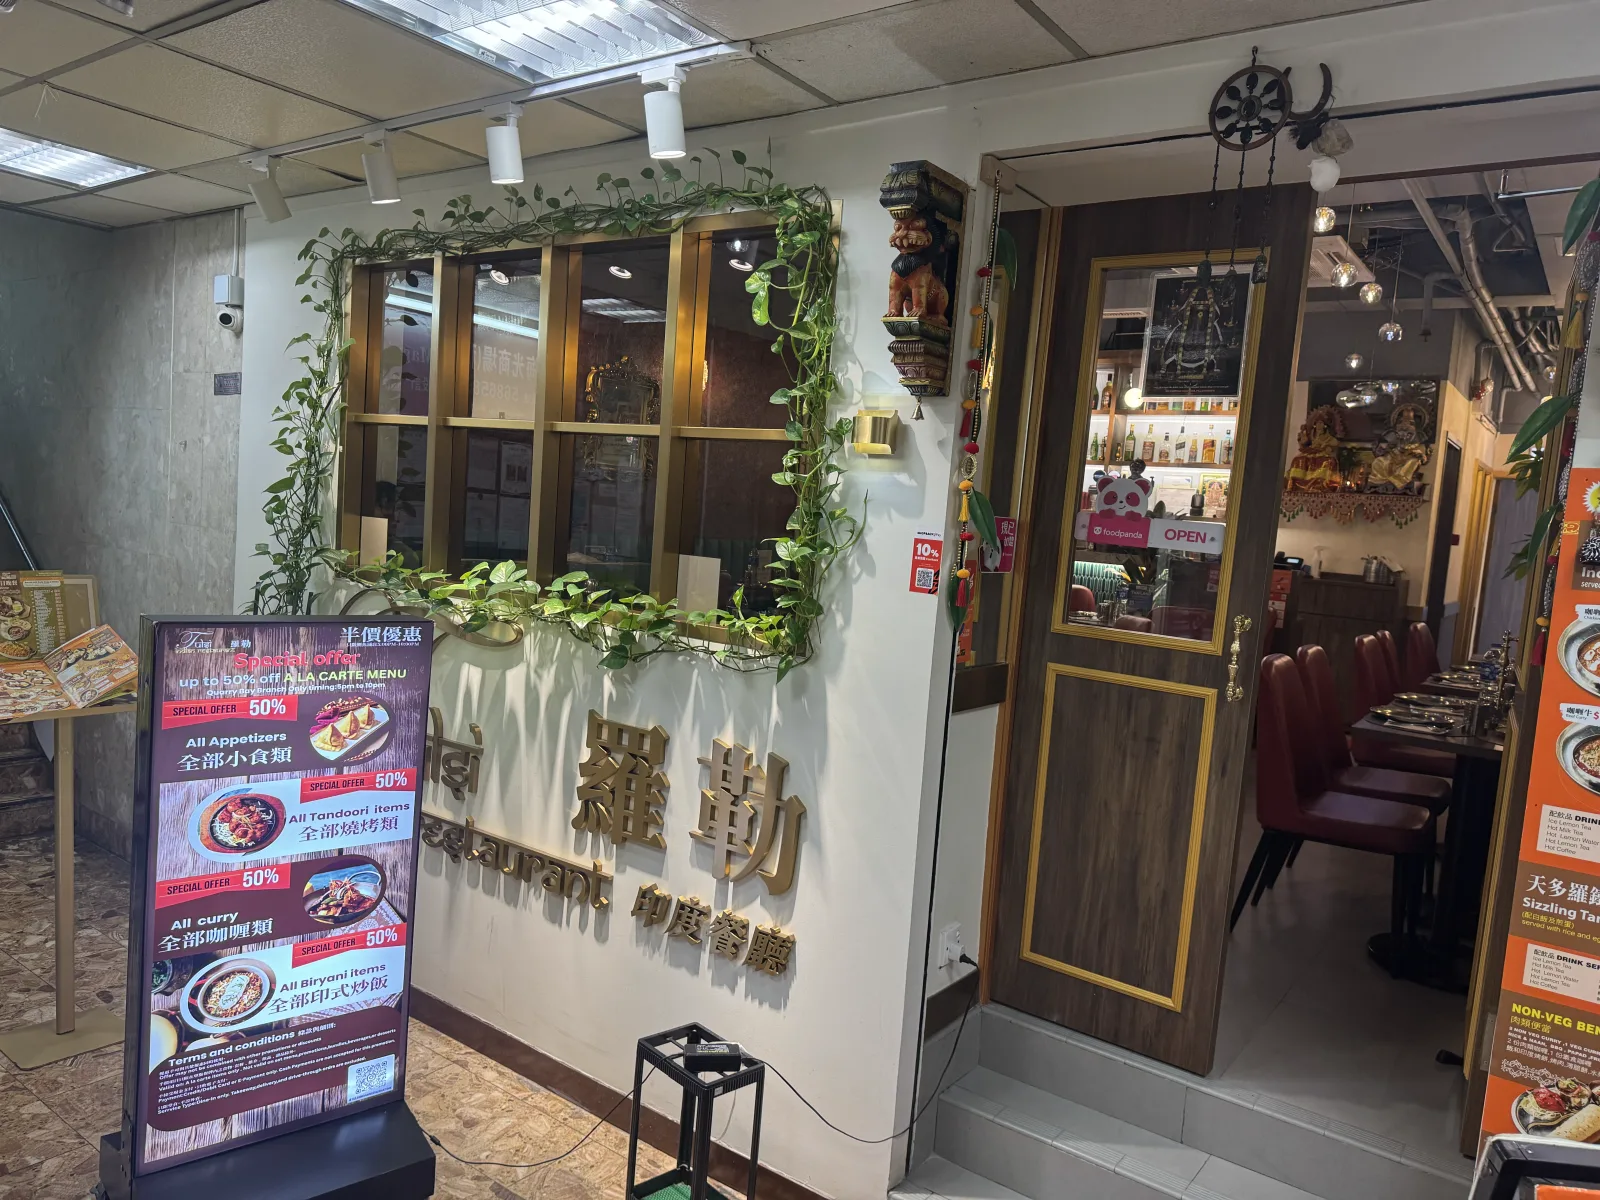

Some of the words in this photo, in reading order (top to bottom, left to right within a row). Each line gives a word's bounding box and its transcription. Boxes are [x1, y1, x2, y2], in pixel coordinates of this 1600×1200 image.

[1103, 526, 1143, 539] foodpanda
[1164, 528, 1208, 544] OPEN
[916, 543, 939, 558] 10%
[340, 626, 422, 643] 半價優惠
[233, 650, 308, 671] Special
[313, 649, 360, 666] offer
[179, 679, 198, 689] up
[203, 676, 219, 686] to
[223, 674, 255, 685] 50%
[259, 673, 280, 683] off
[283, 673, 293, 683] A
[297, 672, 315, 682] LA
[318, 670, 363, 681] CARTE
[367, 669, 407, 679] MENU
[206, 689, 238, 698] Quarry
[257, 686, 287, 694] Branch
[288, 684, 307, 693] Only
[365, 682, 386, 690] 10pm
[172, 706, 209, 717] SPECIAL
[210, 704, 237, 715] OFFER
[249, 698, 287, 717] 50%
[185, 737, 214, 749] All
[215, 733, 287, 749] Appetizers
[177, 746, 292, 772] 全部小食類
[309, 780, 341, 792] SPECIAL
[342, 777, 365, 789] OFFER
[374, 771, 408, 789] 50%
[288, 811, 307, 825] All
[309, 805, 369, 823] Tandoori
[374, 802, 410, 815] items
[299, 815, 400, 843] 全部燒烤類
[1559, 820, 1580, 829] Lemon
[1581, 823, 1592, 831] Tea
[1557, 840, 1578, 849] Lemon
[1579, 843, 1590, 851] Tea
[1559, 834, 1581, 842] Lemon
[1556, 846, 1577, 855] Coffee
[421, 815, 614, 910] estaurant
[166, 881, 202, 895] SPECIAL
[204, 877, 231, 891] OFFER
[242, 867, 280, 888] 50%
[1522, 896, 1577, 921] Sizzling
[171, 917, 192, 931] All
[197, 911, 239, 927] curry
[630, 882, 796, 976] 印度餐廳
[1521, 920, 1546, 929] served
[1546, 924, 1561, 933] with
[1562, 928, 1576, 937] rice
[1576, 932, 1591, 940] and
[157, 917, 274, 954] 全部咖喱類
[301, 941, 332, 956] SPECIAL
[333, 937, 356, 951] OFFER
[365, 927, 398, 947] 50%
[1542, 958, 1562, 967] Lemon
[1556, 954, 1584, 967] DRINK
[279, 980, 297, 994] All
[300, 970, 349, 989] Biryani
[350, 963, 386, 978] items
[1540, 975, 1560, 984] Lemon
[1543, 970, 1562, 979] Lemon
[267, 974, 389, 1016] 全部印式炒飯
[1510, 1015, 1552, 1034] 肉類便當
[1511, 1003, 1573, 1028] NON-VEG
[1541, 1033, 1562, 1044] CURRY
[168, 1051, 208, 1067] Terms
[209, 1045, 233, 1058] and
[234, 1031, 296, 1051] conditions
